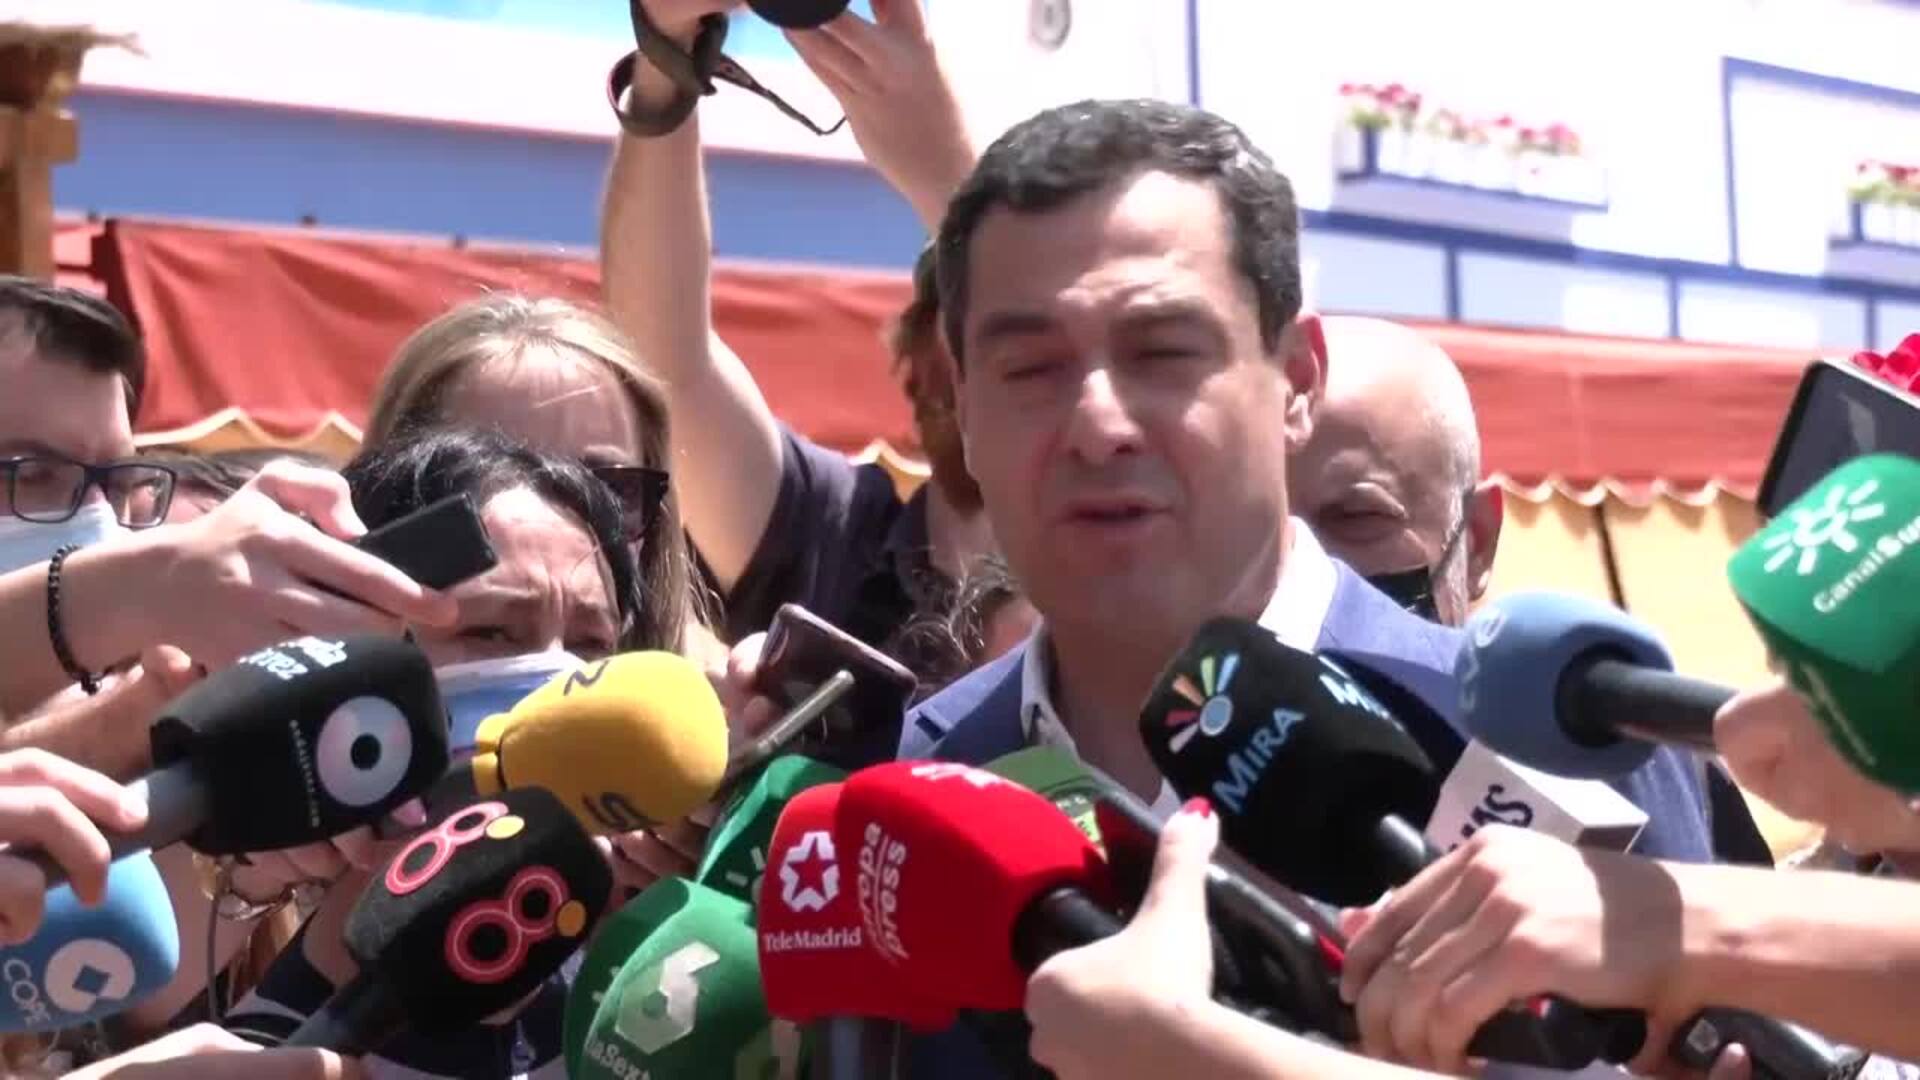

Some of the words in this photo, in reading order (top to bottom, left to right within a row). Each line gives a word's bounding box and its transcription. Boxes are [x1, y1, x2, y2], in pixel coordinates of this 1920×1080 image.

[1212, 707, 1306, 813] MIRA
[765, 927, 862, 952] TeleMadrid
[880, 840, 909, 959] press
